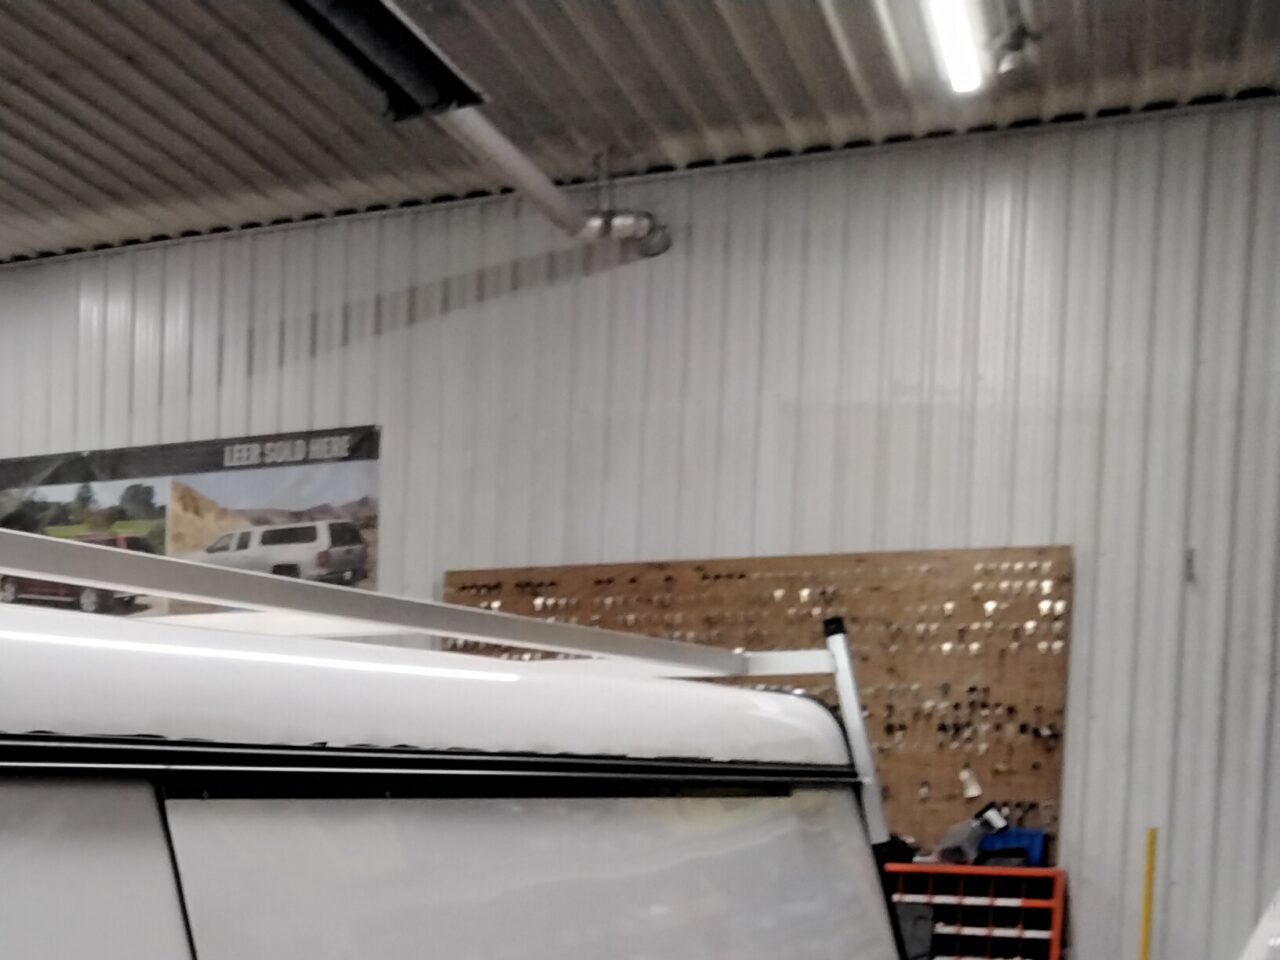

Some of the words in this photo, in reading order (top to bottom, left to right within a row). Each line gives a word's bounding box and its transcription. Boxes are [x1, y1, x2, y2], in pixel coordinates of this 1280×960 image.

[223, 443, 261, 467] LEER
[263, 440, 306, 463] SOLD
[309, 435, 351, 460] HERE
